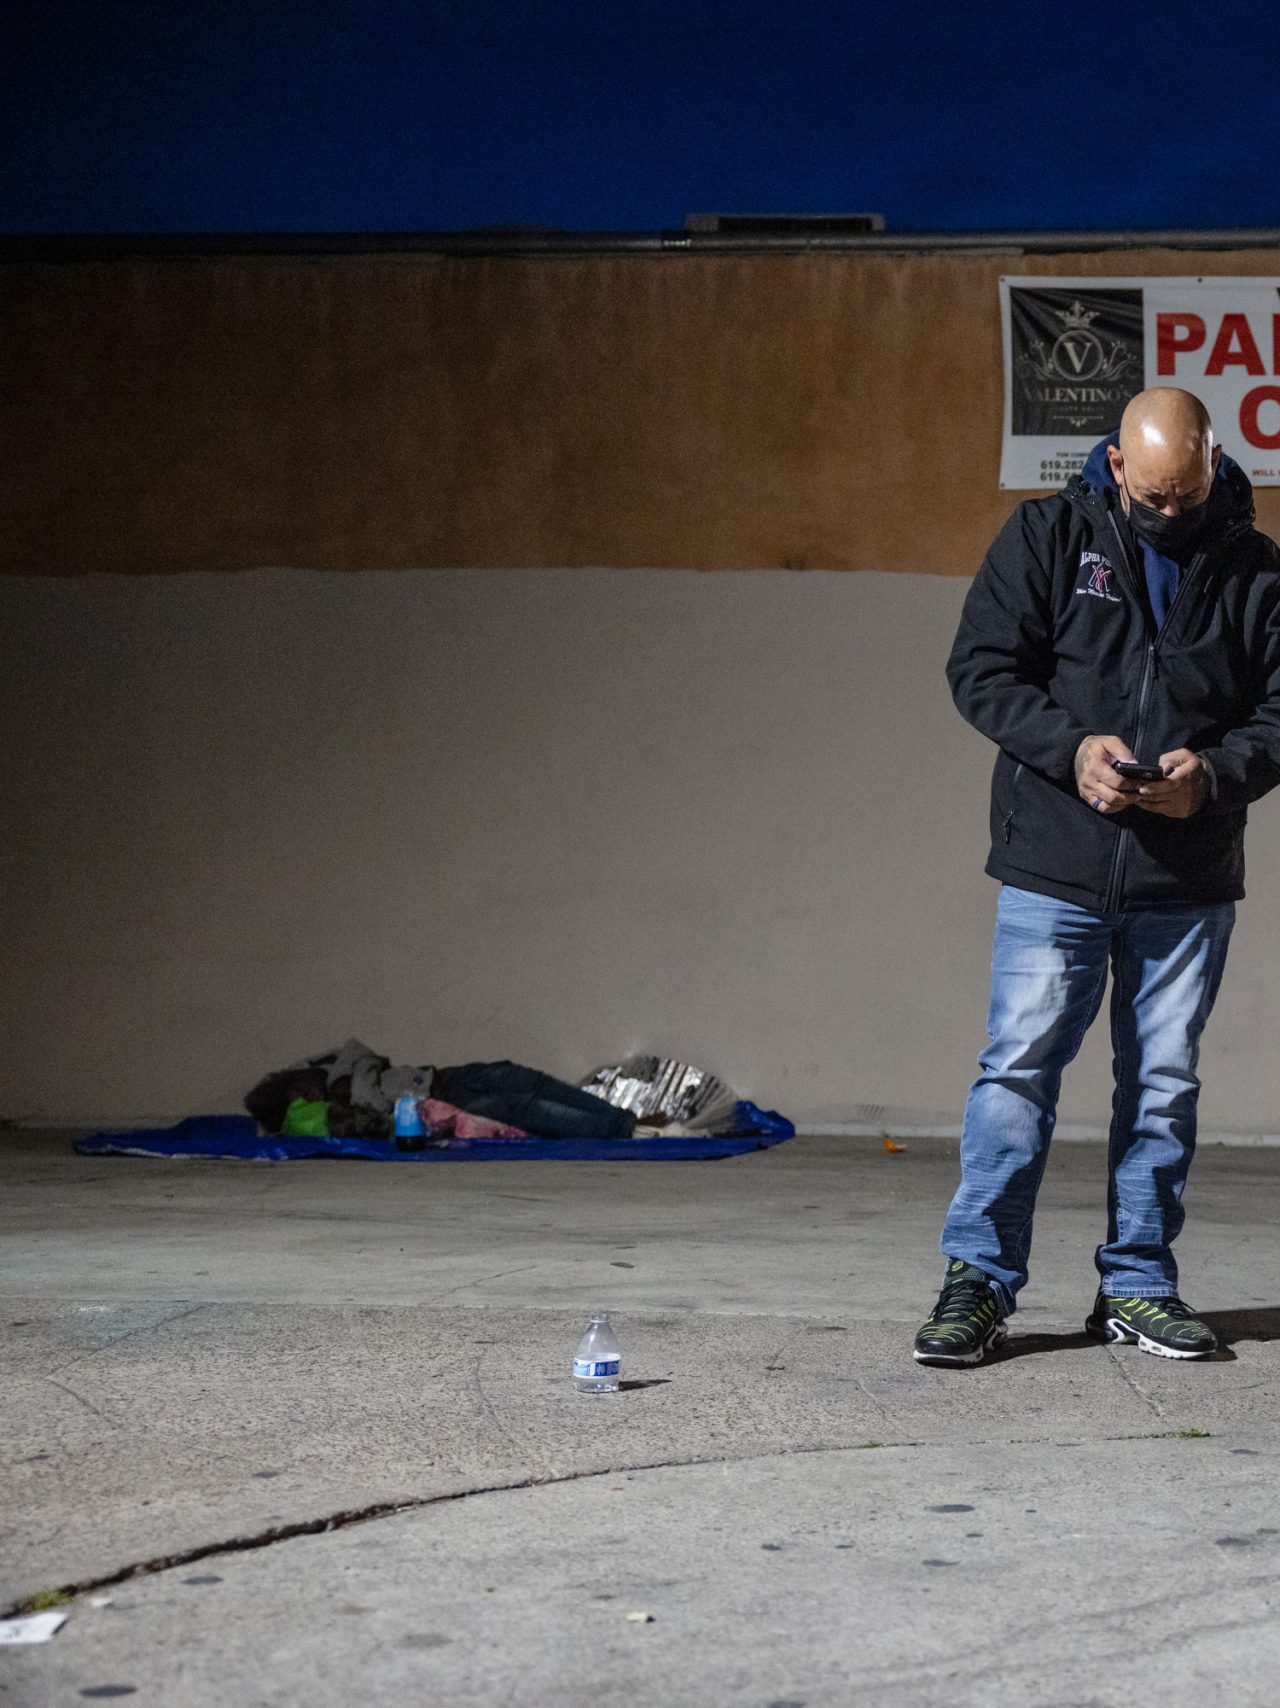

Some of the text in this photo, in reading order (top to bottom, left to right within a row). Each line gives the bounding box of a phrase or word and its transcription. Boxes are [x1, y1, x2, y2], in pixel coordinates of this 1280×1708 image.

[1063, 342, 1093, 373] V
[1040, 460, 1084, 470] 619.282
[1252, 469, 1275, 477] WILL
